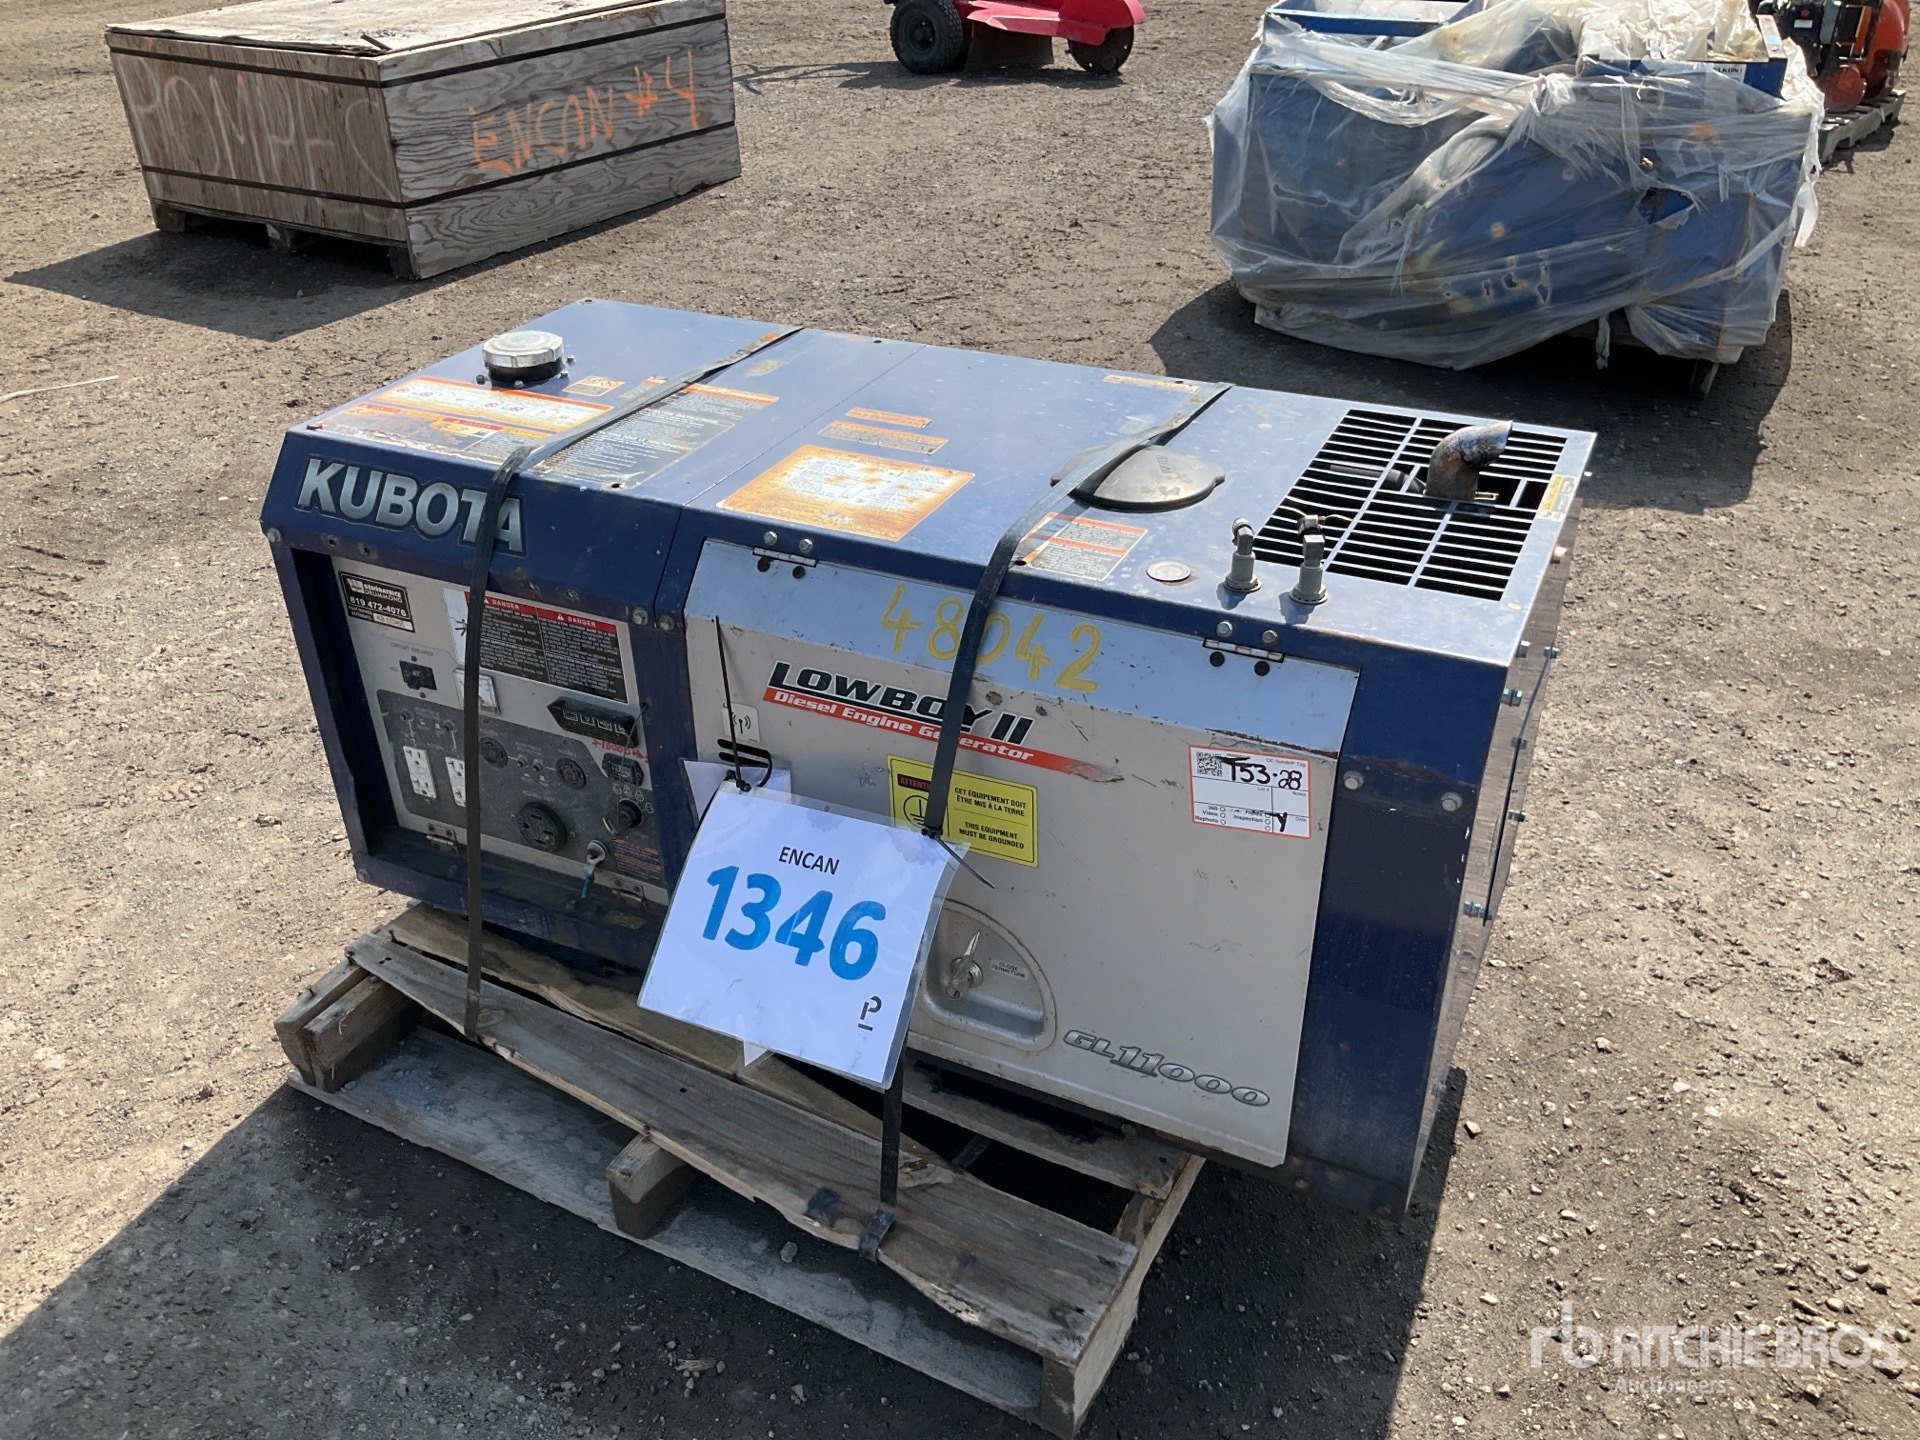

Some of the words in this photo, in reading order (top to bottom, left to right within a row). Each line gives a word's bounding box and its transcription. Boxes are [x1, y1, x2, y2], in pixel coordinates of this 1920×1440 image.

[468, 84, 613, 174] ENCAN
[297, 457, 523, 553] KUBOTA
[349, 596, 366, 607] 819
[367, 600, 407, 617] 472-4076
[491, 598, 520, 611] DANGER
[567, 615, 597, 628] DANGER
[880, 583, 1102, 692] 48042
[768, 661, 992, 727] LOWBOY
[774, 690, 837, 715] Diesel
[841, 708, 913, 733] Engine
[918, 724, 1034, 762] Geerator
[954, 787, 967, 795] CET
[968, 789, 1010, 805] ÉQUIPEMENT
[1010, 800, 1026, 809] DOIT
[956, 794, 973, 805] ÊTRE
[974, 800, 987, 809] MIS
[988, 801, 993, 810] À
[994, 804, 1003, 812] LA
[1004, 806, 1025, 817] TERRE
[964, 821, 980, 831] THIS
[980, 825, 1018, 840] EQUIPMENT
[1233, 814, 1263, 823] Inspection
[959, 828, 978, 838] MUST
[979, 832, 987, 840] BE
[988, 835, 1025, 850] GROUNDED
[778, 846, 840, 875] ENCAN
[702, 865, 887, 981] 1346
[1063, 1029, 1271, 1107] GL11000
